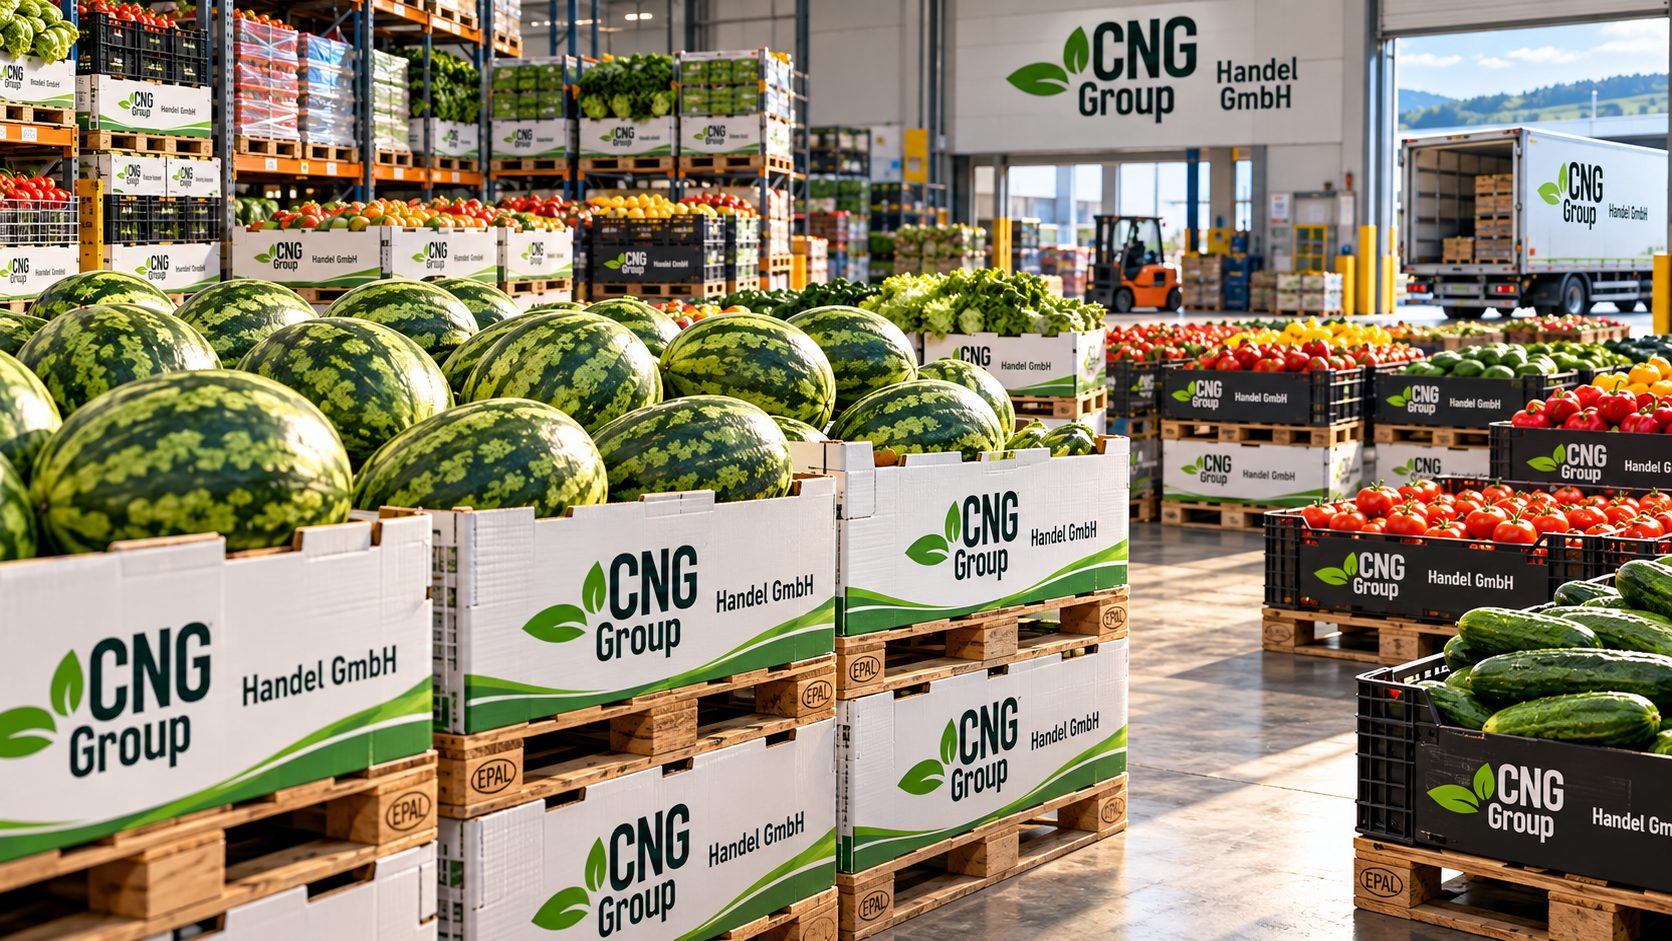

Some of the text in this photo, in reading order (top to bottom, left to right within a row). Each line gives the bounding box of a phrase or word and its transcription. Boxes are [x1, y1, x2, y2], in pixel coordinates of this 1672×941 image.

[1092, 15, 1197, 81] CNG
[7, 64, 24, 81] CNG
[1216, 57, 1298, 84] Handel
[134, 91, 153, 108] CNG
[1078, 81, 1175, 124] Group
[1220, 84, 1291, 110] GmbH
[132, 106, 151, 119] Group
[516, 129, 533, 141] CNG
[615, 127, 634, 139] CNG
[708, 125, 726, 137] CNG
[128, 164, 140, 177] CNG
[1568, 161, 1603, 203] CNG
[1563, 198, 1596, 230] Group
[1609, 203, 1648, 221] Handel GmbH
[277, 242, 302, 260] CNG
[312, 255, 335, 263] Handel
[429, 241, 447, 259] CNG
[532, 242, 544, 256] CNG
[625, 252, 647, 266] CNG
[13, 258, 29, 274] CNG
[151, 255, 169, 270] CNG
[273, 259, 298, 271] Group
[622, 265, 645, 277] Group
[960, 346, 991, 367] CNG
[1001, 361, 1051, 371] Handel GmbH
[1196, 380, 1222, 398] CNG
[1235, 392, 1288, 404] Handel GmbH
[1412, 384, 1439, 404] CNG
[1192, 397, 1219, 410] Group
[1407, 401, 1436, 416] Group
[1449, 397, 1501, 410] Handel GmbH
[1204, 454, 1231, 473] CNG
[1566, 443, 1607, 467] CNG
[1243, 470, 1295, 481] Handel GmbH
[1414, 457, 1441, 475] CNG
[1561, 465, 1602, 483] Group
[1624, 459, 1661, 473] Handel
[1200, 472, 1228, 486] Group
[962, 490, 1018, 548] CNG
[1031, 520, 1097, 547] Handel GmbH
[954, 548, 1008, 581] Group
[1358, 551, 1405, 580] CNG
[609, 544, 698, 621] CNG
[1353, 577, 1399, 600] Group
[1428, 569, 1514, 591] Handel GmbH
[716, 574, 814, 613] Handel GmbH
[596, 617, 681, 662] Group
[89, 621, 211, 722] CNG
[242, 645, 397, 707] Handel GmbH
[853, 660, 877, 678] EPAL
[806, 685, 829, 704] EPAL
[959, 697, 1018, 766] CNG
[1031, 711, 1099, 750] Handel GmbH
[69, 715, 190, 778] Group
[477, 764, 512, 789] EPAL
[951, 758, 1008, 802] Group
[1497, 763, 1564, 812] CNG
[392, 797, 426, 826] EPAL
[1592, 807, 1645, 833] Handel
[1488, 802, 1555, 843] Group
[609, 802, 690, 892] CNG
[708, 811, 804, 868] Handel GmbH
[1365, 871, 1398, 894] EPAL
[598, 879, 676, 938] Group
[862, 893, 887, 918] EPAL
